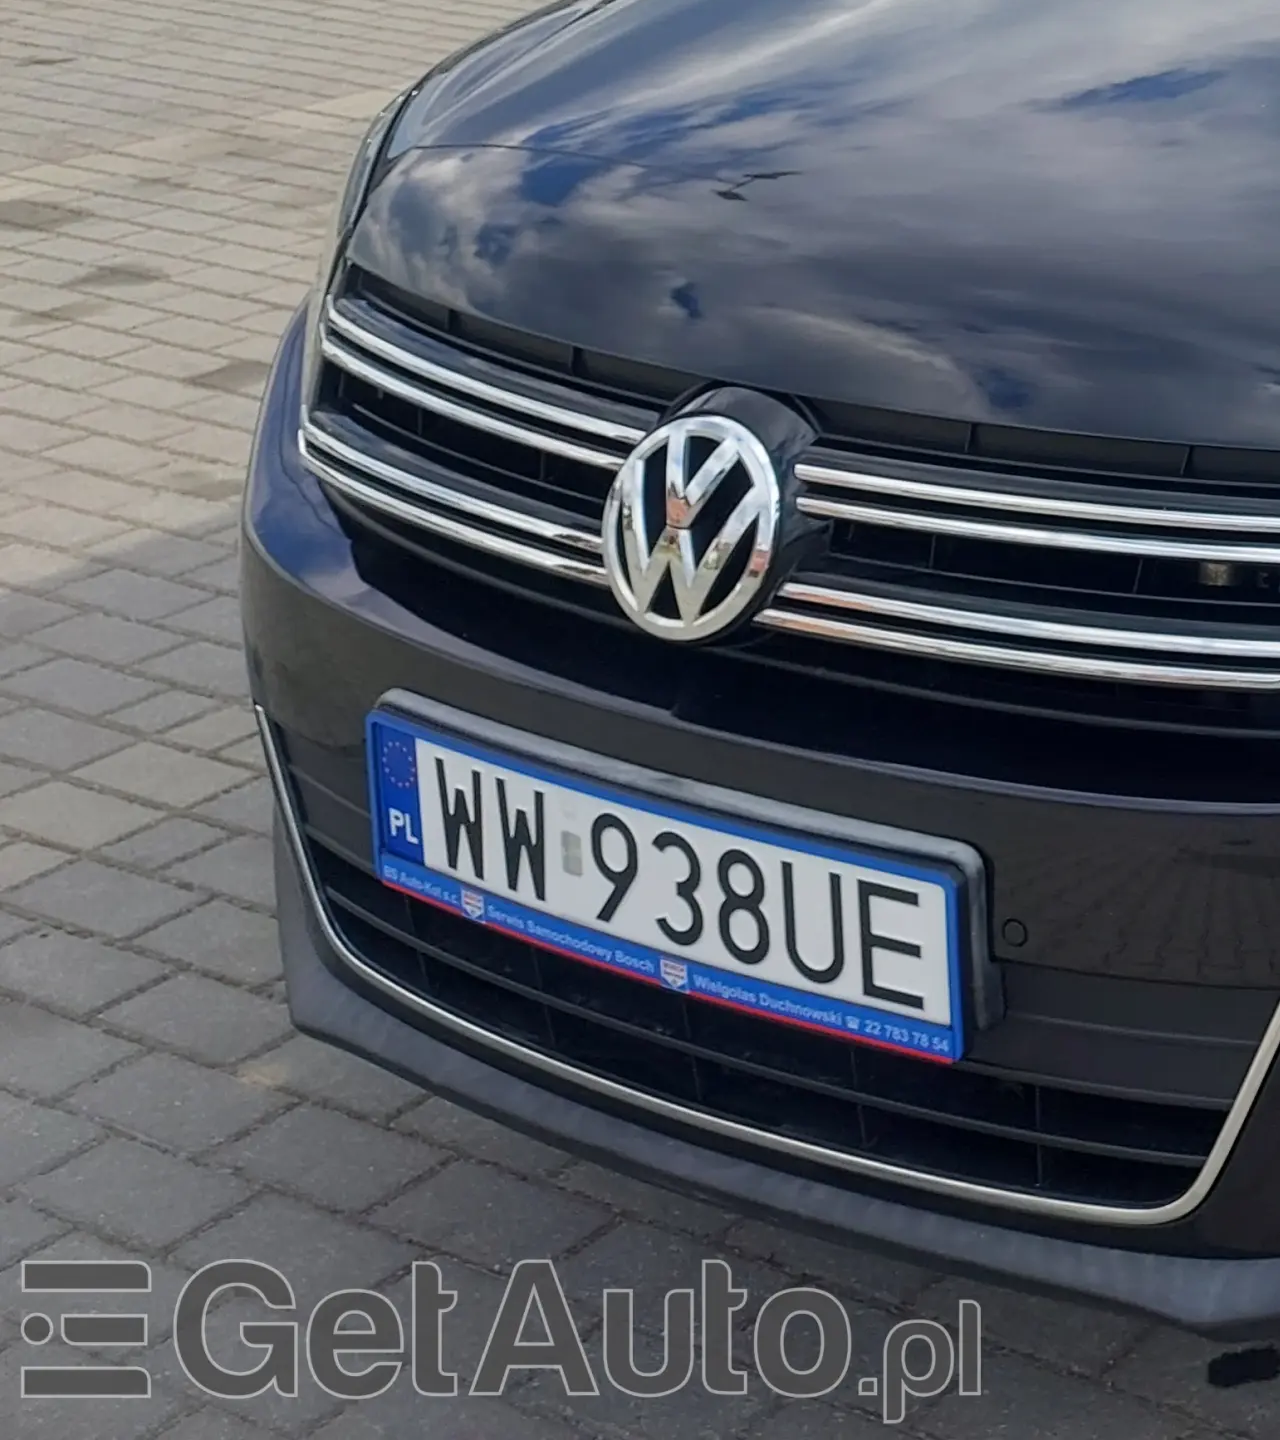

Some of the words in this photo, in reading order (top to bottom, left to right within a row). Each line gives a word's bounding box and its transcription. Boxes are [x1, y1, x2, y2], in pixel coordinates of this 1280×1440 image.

[389, 807, 420, 845] PL
[435, 756, 546, 902] WW
[590, 812, 926, 1011] 938UE
[614, 947, 655, 974] Bosch
[863, 1020, 882, 1037] 22
